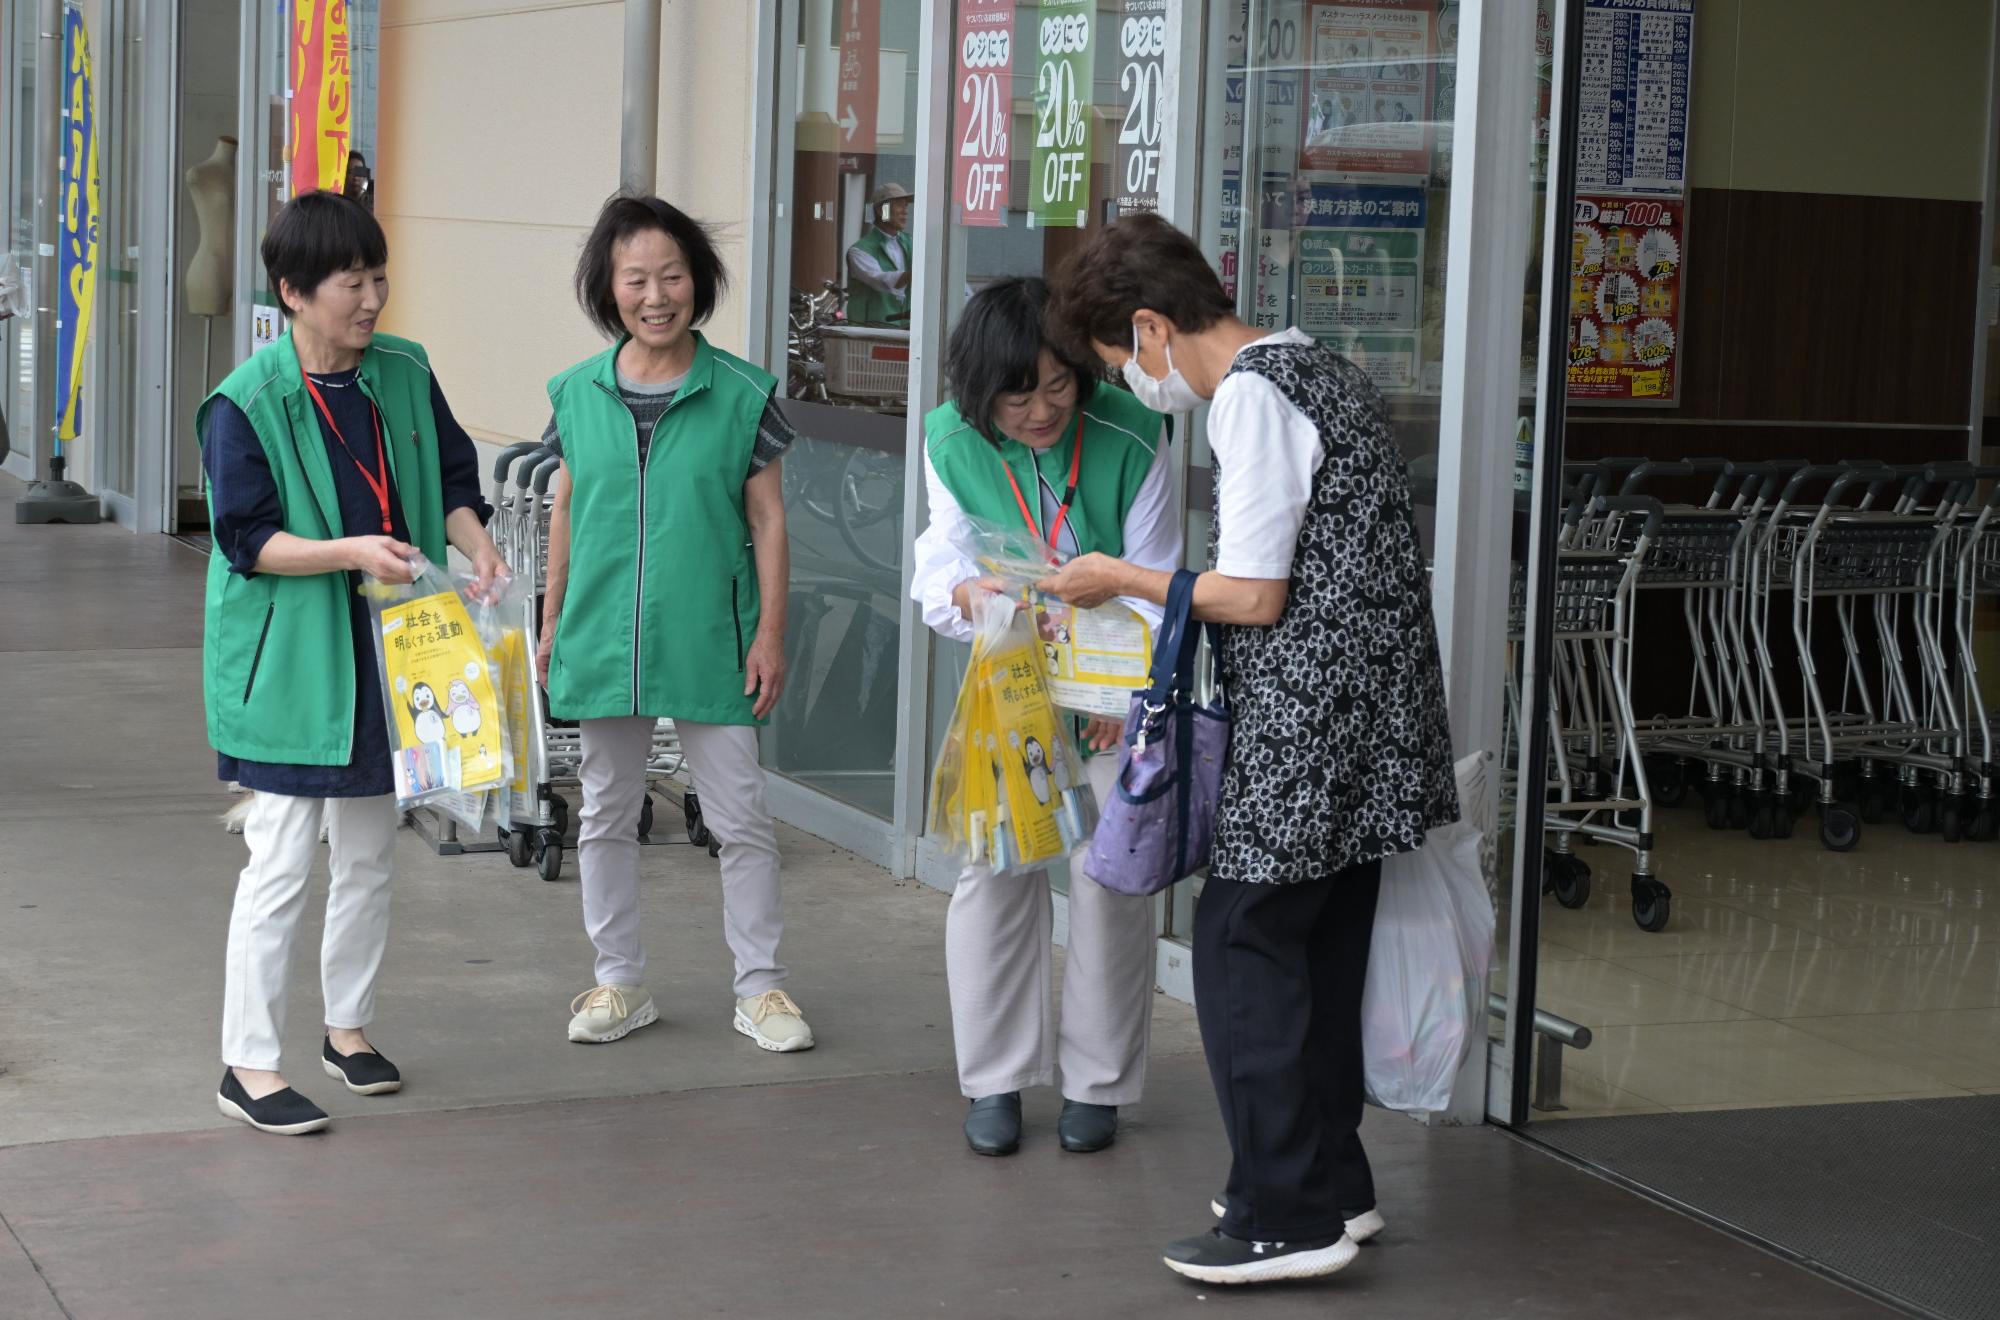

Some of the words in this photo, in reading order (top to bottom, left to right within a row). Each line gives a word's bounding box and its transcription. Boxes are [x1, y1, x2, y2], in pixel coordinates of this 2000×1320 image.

[965, 35, 1009, 61] レジにて
[1041, 19, 1087, 50] レジにて
[961, 73, 1007, 158] 20%
[1036, 59, 1086, 149] 20%
[965, 163, 1005, 211] OFF
[1043, 152, 1085, 203] OFF
[1126, 149, 1160, 194] OF
[1303, 198, 1420, 217] 決済方法のご案内
[1312, 263, 1374, 273] クレジトカード
[406, 609, 442, 628] 社会を
[394, 620, 463, 651] 明るくする運動
